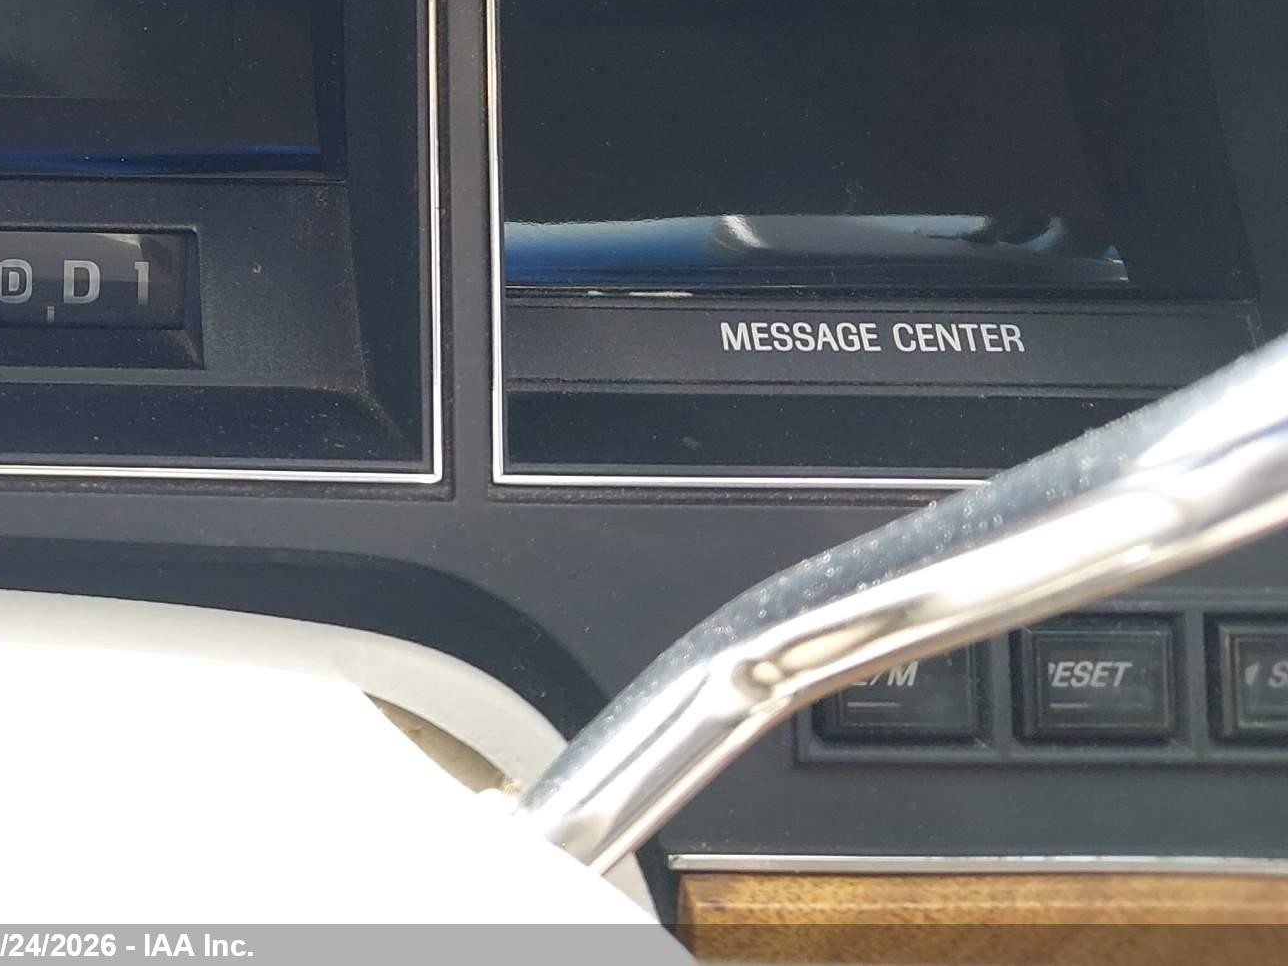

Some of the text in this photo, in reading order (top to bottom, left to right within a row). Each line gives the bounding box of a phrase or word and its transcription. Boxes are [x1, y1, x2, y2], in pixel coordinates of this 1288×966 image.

[63, 259, 101, 304] D
[134, 260, 150, 306] 1
[720, 321, 1026, 353] MESSAGE CENTER
